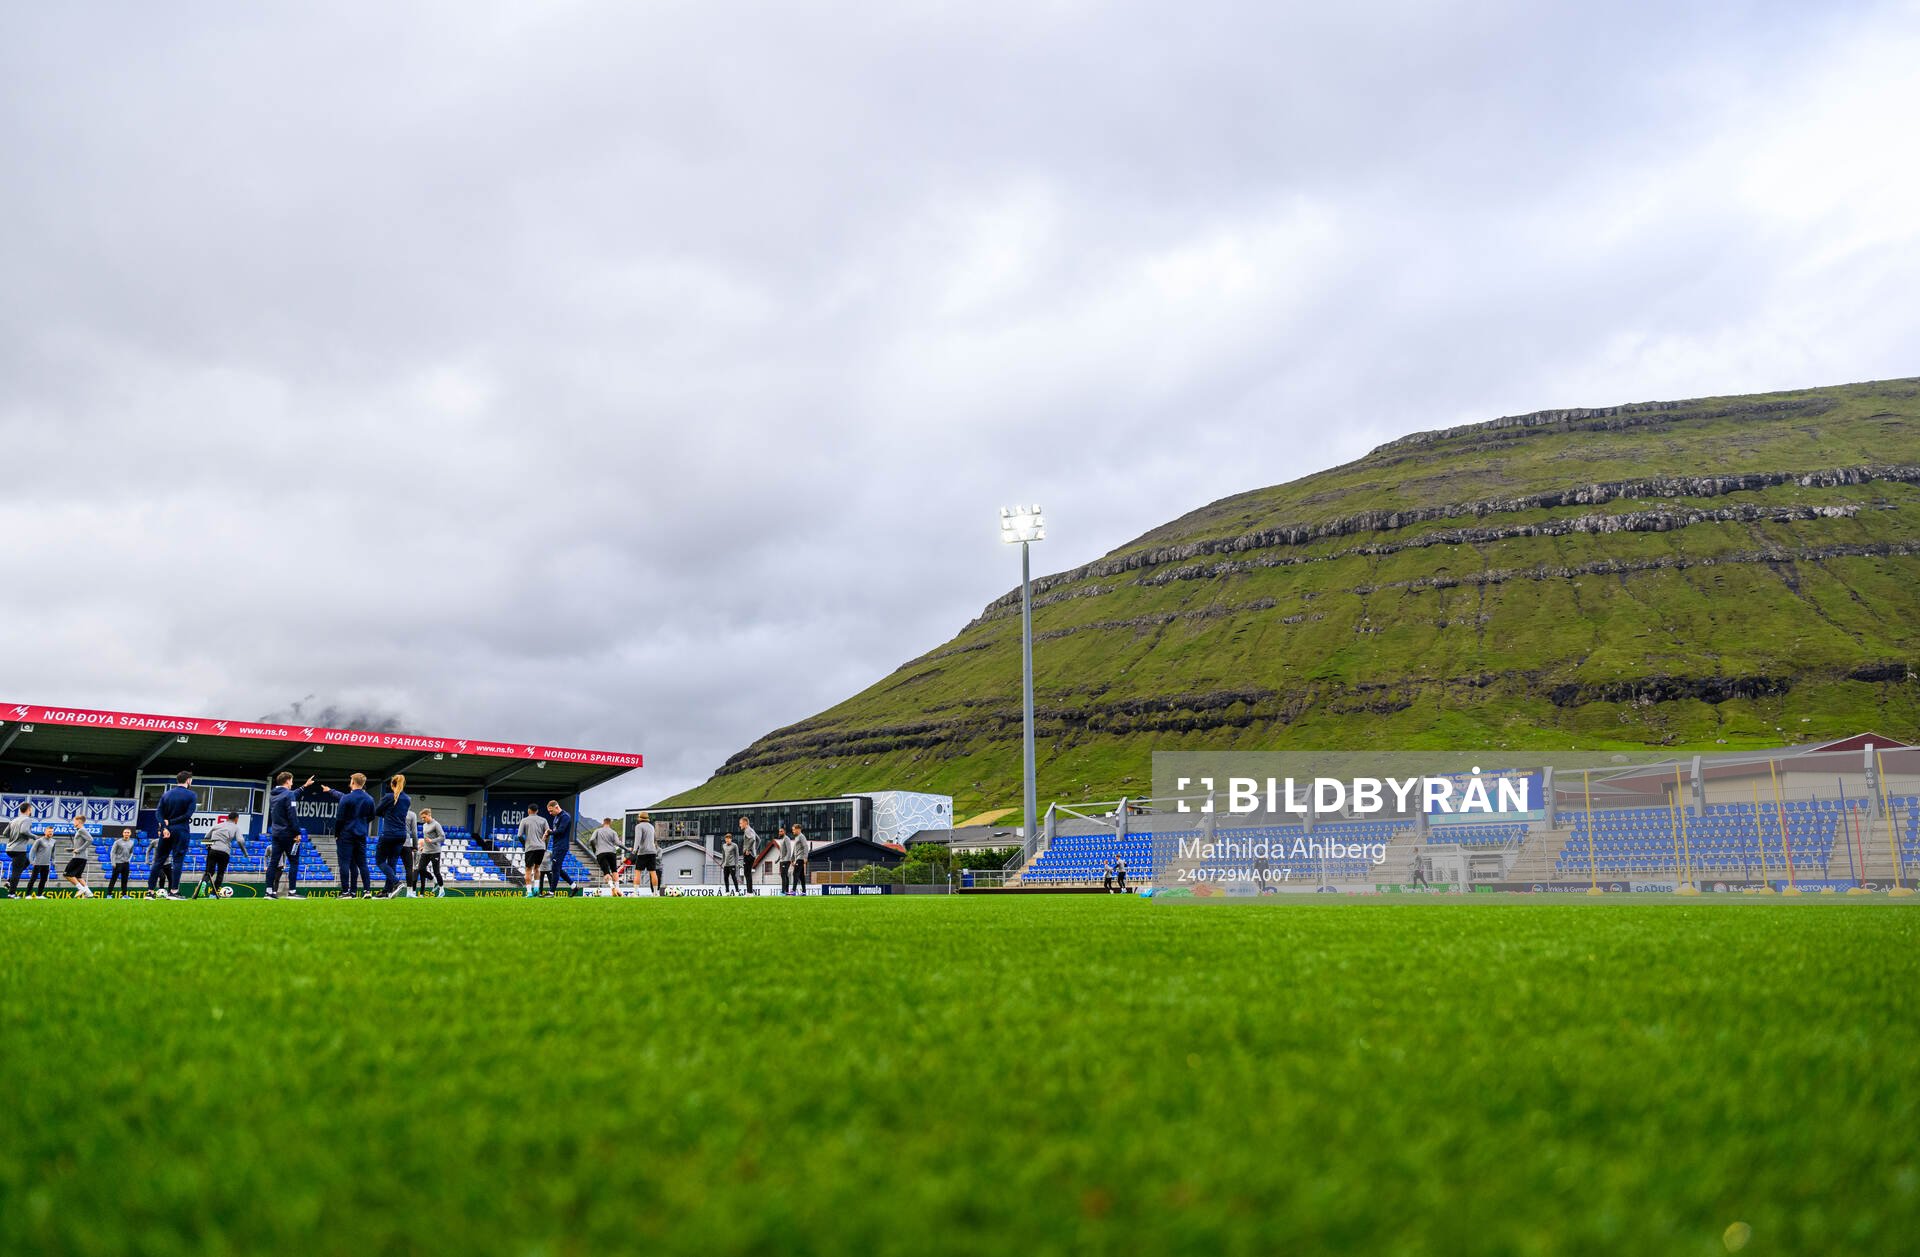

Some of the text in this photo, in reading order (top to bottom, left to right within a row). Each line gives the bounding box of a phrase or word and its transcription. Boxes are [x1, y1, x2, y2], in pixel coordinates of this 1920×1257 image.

[43, 710, 199, 731] NORÐOYA SPARIKASSI
[239, 727, 288, 737] www.ns.fo
[325, 732, 445, 749] NORÐOYA SPARIKASSI
[476, 745, 514, 754] www.ns.fo
[590, 754, 640, 765] SPARIKASSI
[682, 888, 714, 897] VICTOR
[829, 886, 851, 895] formula
[858, 886, 881, 895] formula
[1635, 885, 1673, 893] GADUS
